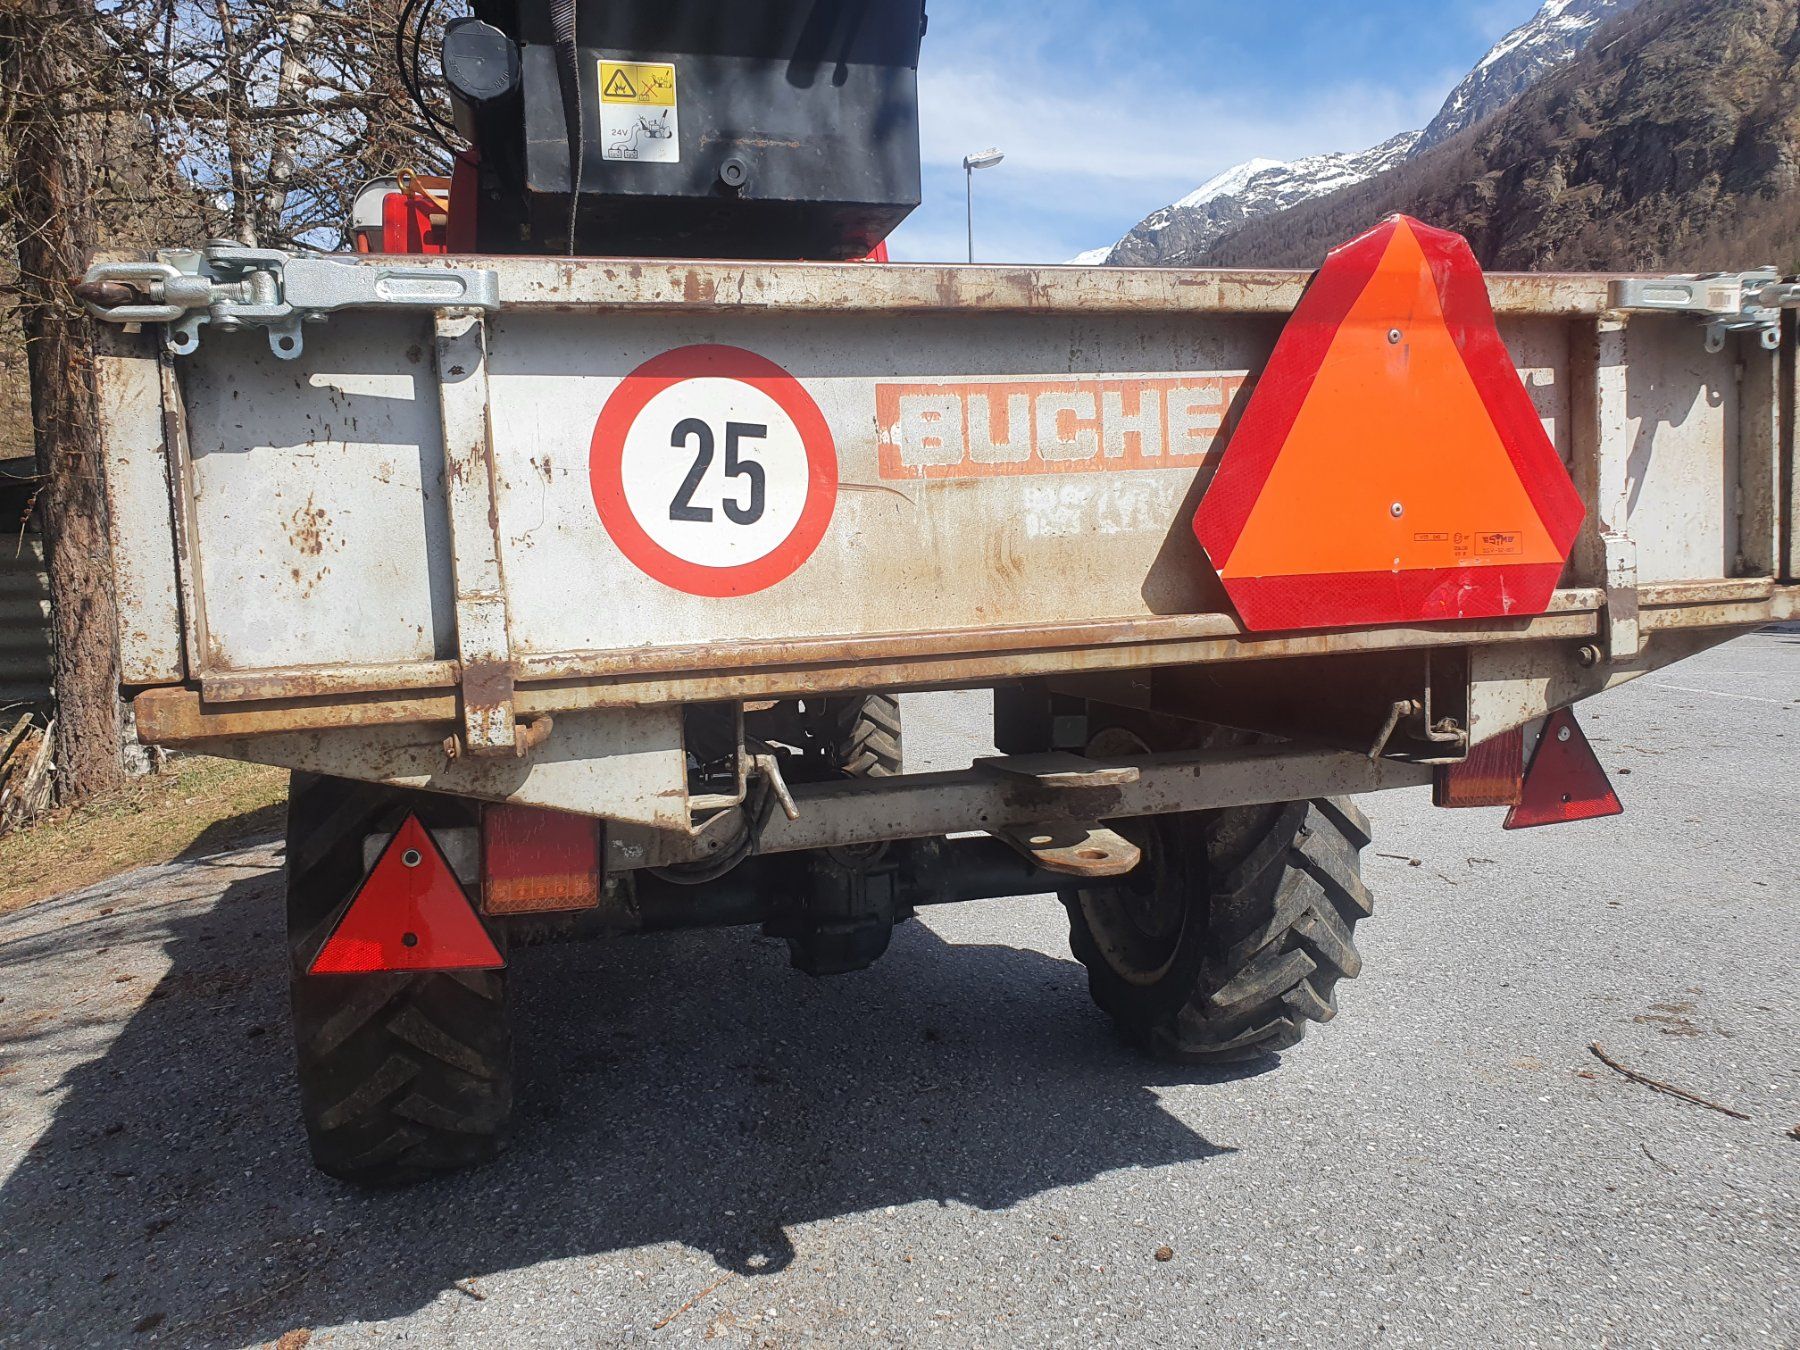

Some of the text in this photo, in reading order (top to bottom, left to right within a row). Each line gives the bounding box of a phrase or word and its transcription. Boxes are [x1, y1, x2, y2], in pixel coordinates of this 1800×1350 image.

[611, 128, 629, 137] 24V
[899, 385, 1247, 467] BUCHE
[669, 417, 768, 526] 25
